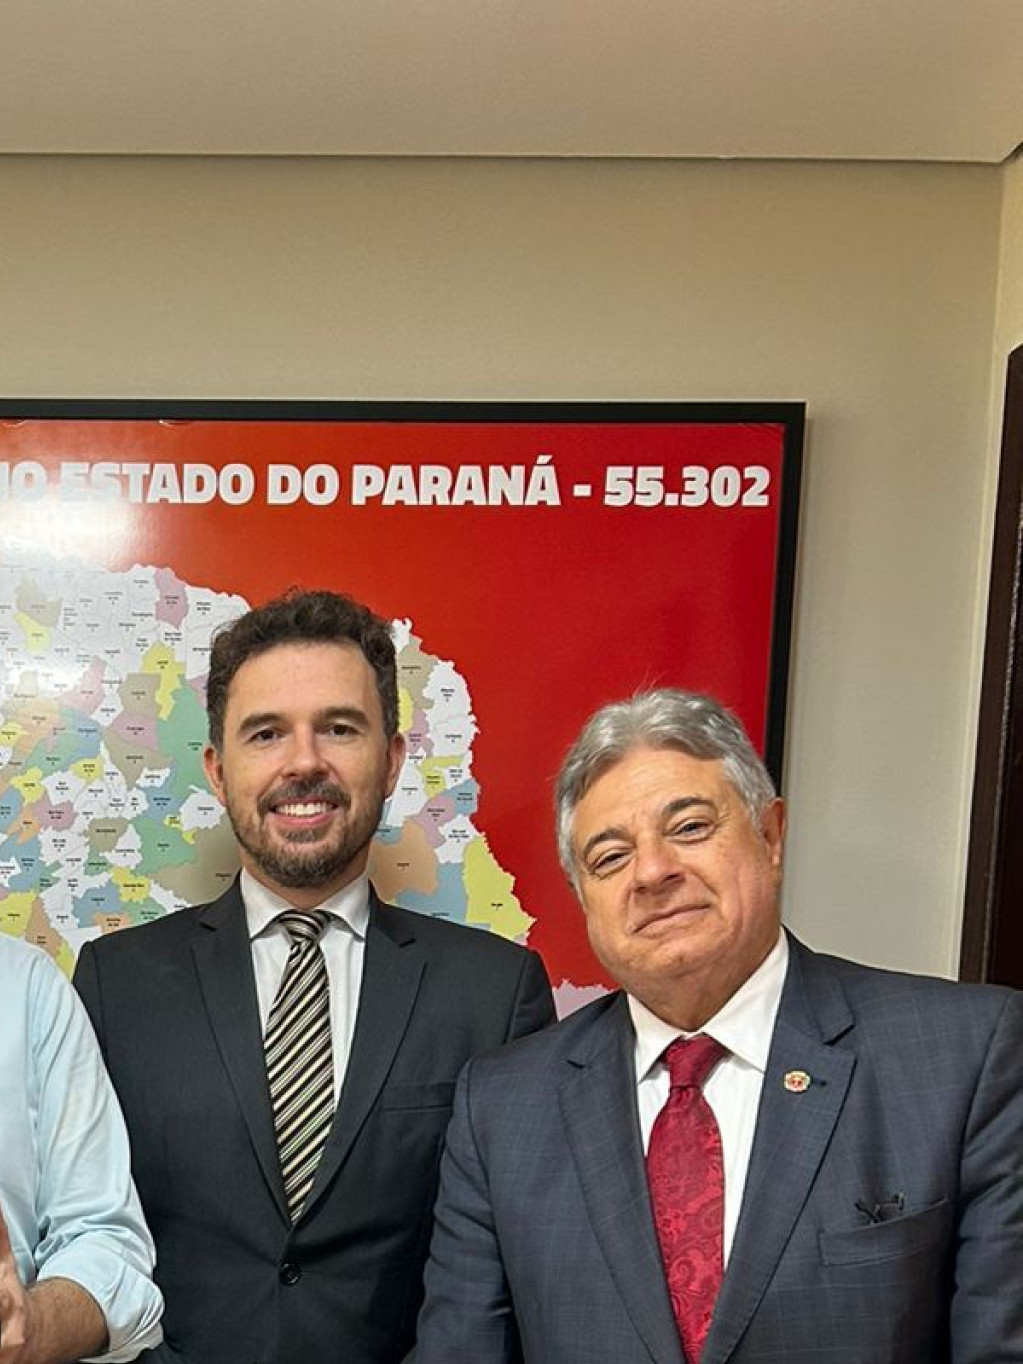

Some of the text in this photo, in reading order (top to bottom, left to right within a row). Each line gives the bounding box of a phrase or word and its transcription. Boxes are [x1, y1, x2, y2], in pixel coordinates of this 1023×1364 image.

[59, 462, 256, 505] ESTADO
[266, 463, 340, 506] DO
[350, 454, 562, 506] PARANÁ
[573, 485, 592, 497] -
[603, 464, 771, 507] 55.302
